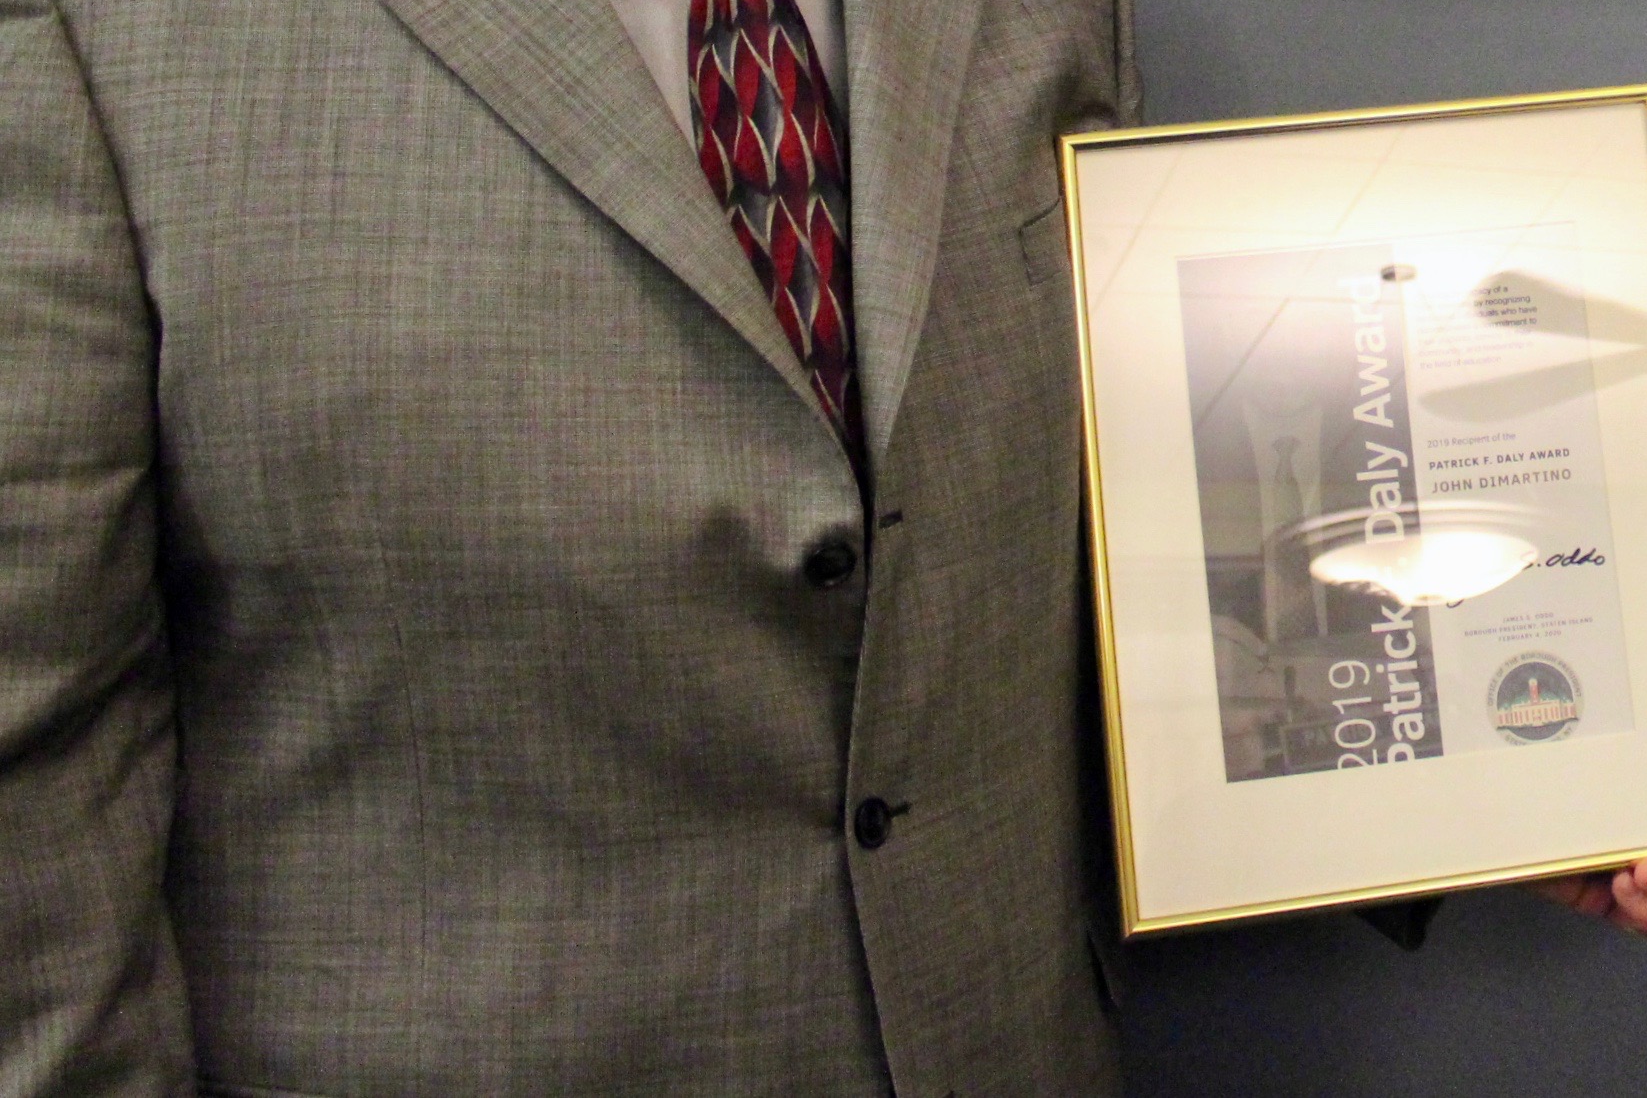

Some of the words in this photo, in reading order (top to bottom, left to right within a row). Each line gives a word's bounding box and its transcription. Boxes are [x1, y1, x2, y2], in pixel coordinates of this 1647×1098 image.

[1485, 296, 1530, 306] recognizing
[1518, 306, 1537, 314] have
[1427, 440, 1450, 448] 2019
[1452, 435, 1489, 445] Recipient
[1492, 433, 1500, 441] of
[1429, 457, 1479, 470] PATRICK
[1484, 456, 1492, 465] F.
[1497, 453, 1524, 463] DALY
[1529, 448, 1570, 460] AWARD
[1432, 478, 1473, 493] JOHN
[1479, 468, 1571, 488] DIMARTINO
[1356, 441, 1408, 544] Daly
[1371, 605, 1425, 763] Patrick
[1328, 660, 1378, 769] 2019
